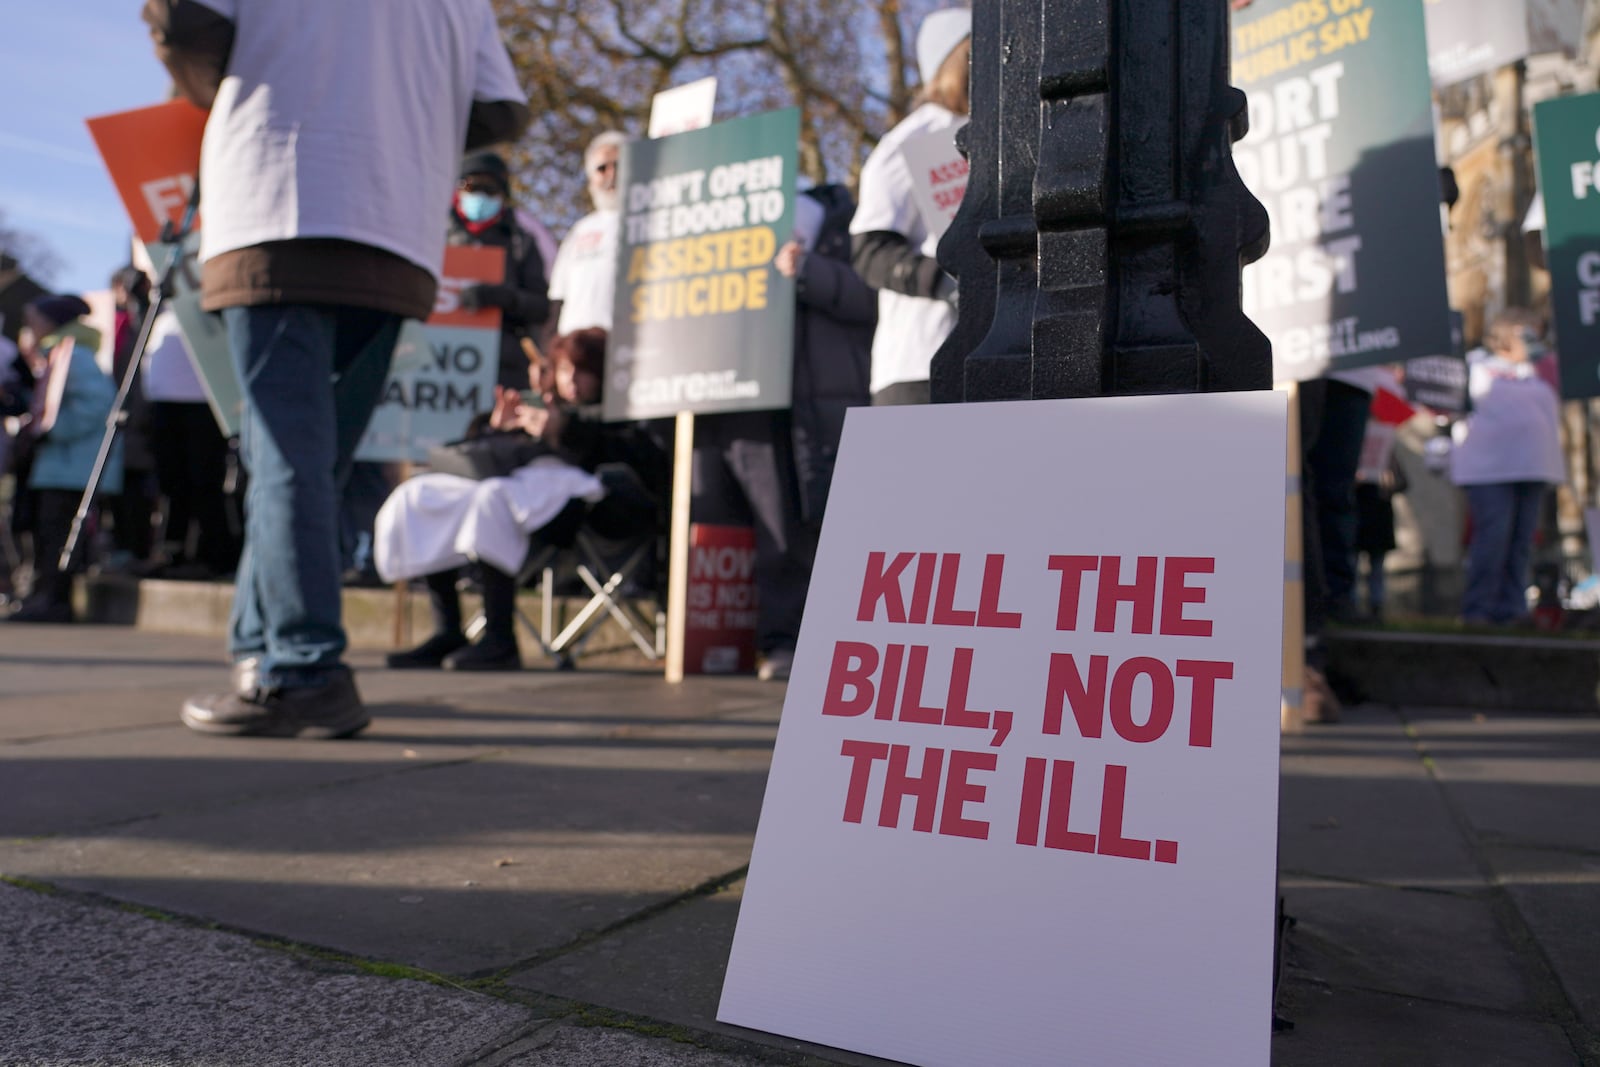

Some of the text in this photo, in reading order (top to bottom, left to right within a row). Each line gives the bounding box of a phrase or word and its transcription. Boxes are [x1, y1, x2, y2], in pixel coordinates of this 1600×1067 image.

[1319, 8, 1373, 54] SAY
[629, 155, 783, 213] DON'T OPEN
[627, 190, 785, 244] THE DOOR TO
[627, 226, 776, 283] ASSISTED
[630, 269, 768, 323] SUICIDE
[856, 551, 1215, 637] KILL THE
[822, 640, 1234, 748] BILL, NOT
[840, 740, 1178, 864] THE ILL.
